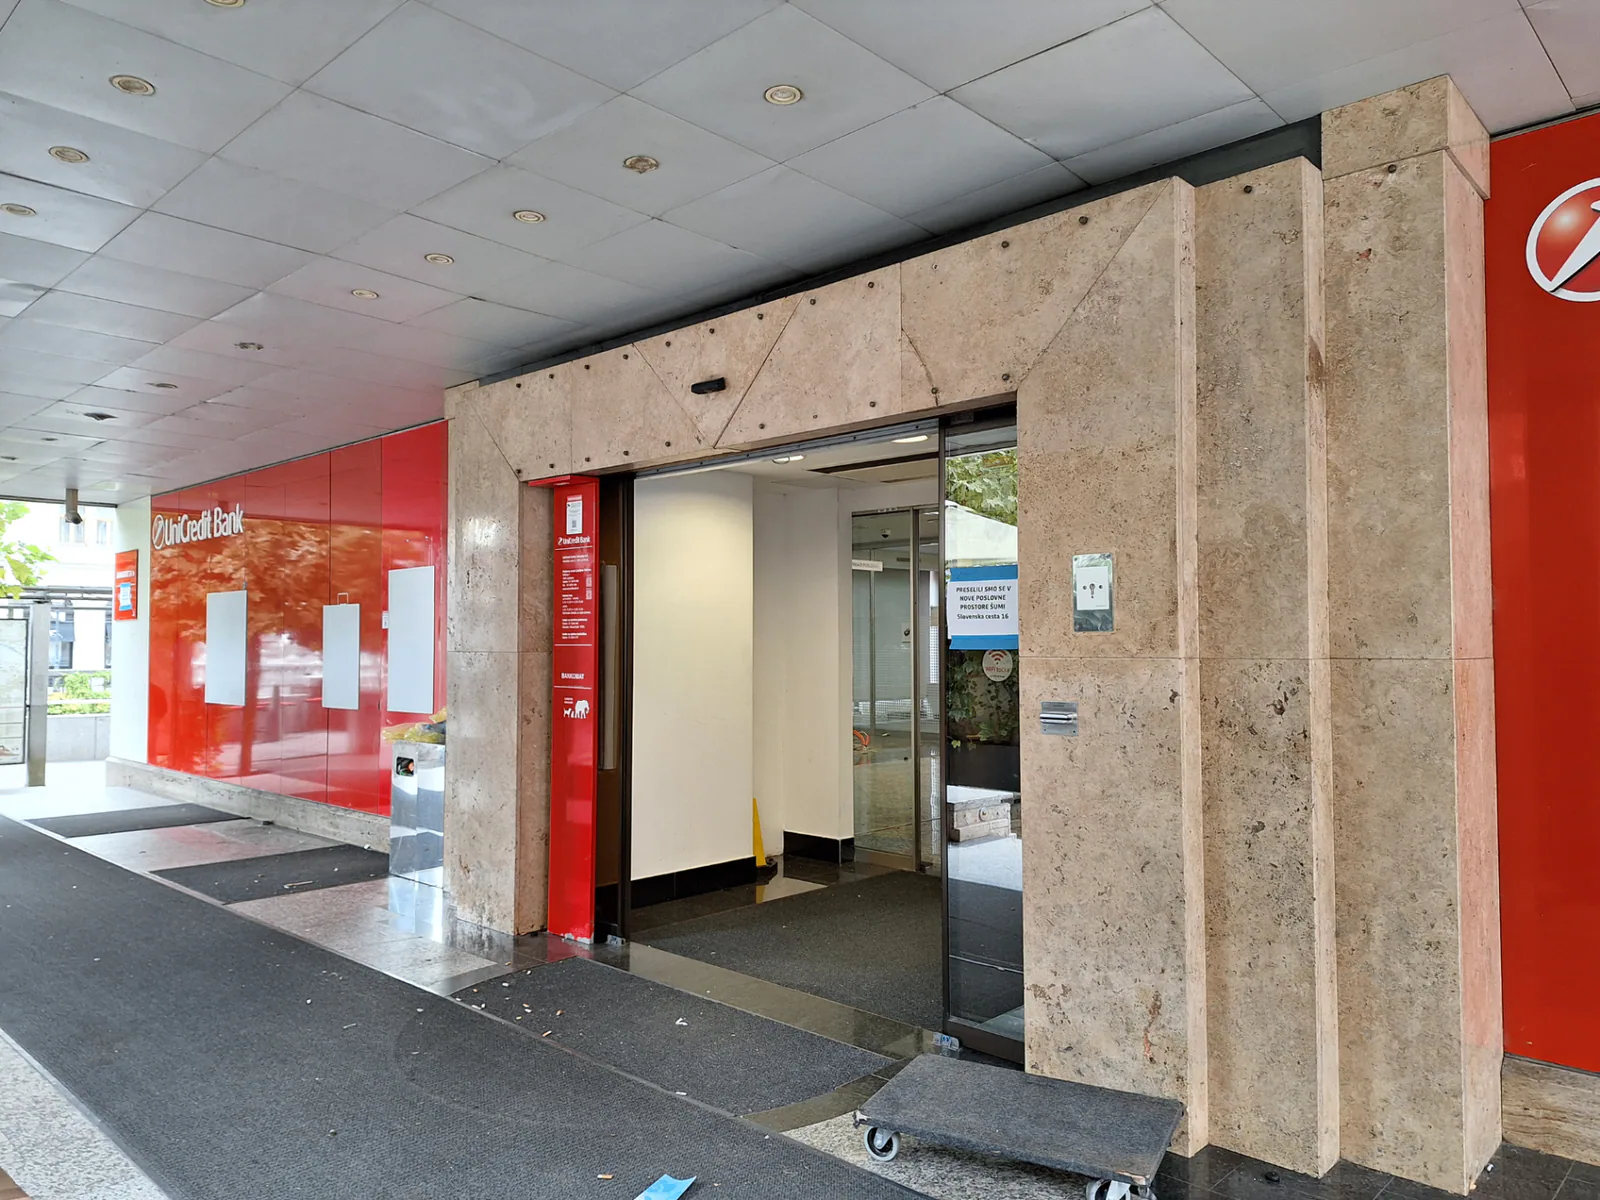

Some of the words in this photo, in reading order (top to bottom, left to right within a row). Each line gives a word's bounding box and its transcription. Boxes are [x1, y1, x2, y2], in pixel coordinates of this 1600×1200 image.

[165, 509, 212, 546] UniCredit
[213, 503, 244, 538] Bank
[990, 602, 1006, 610] ŠUMI
